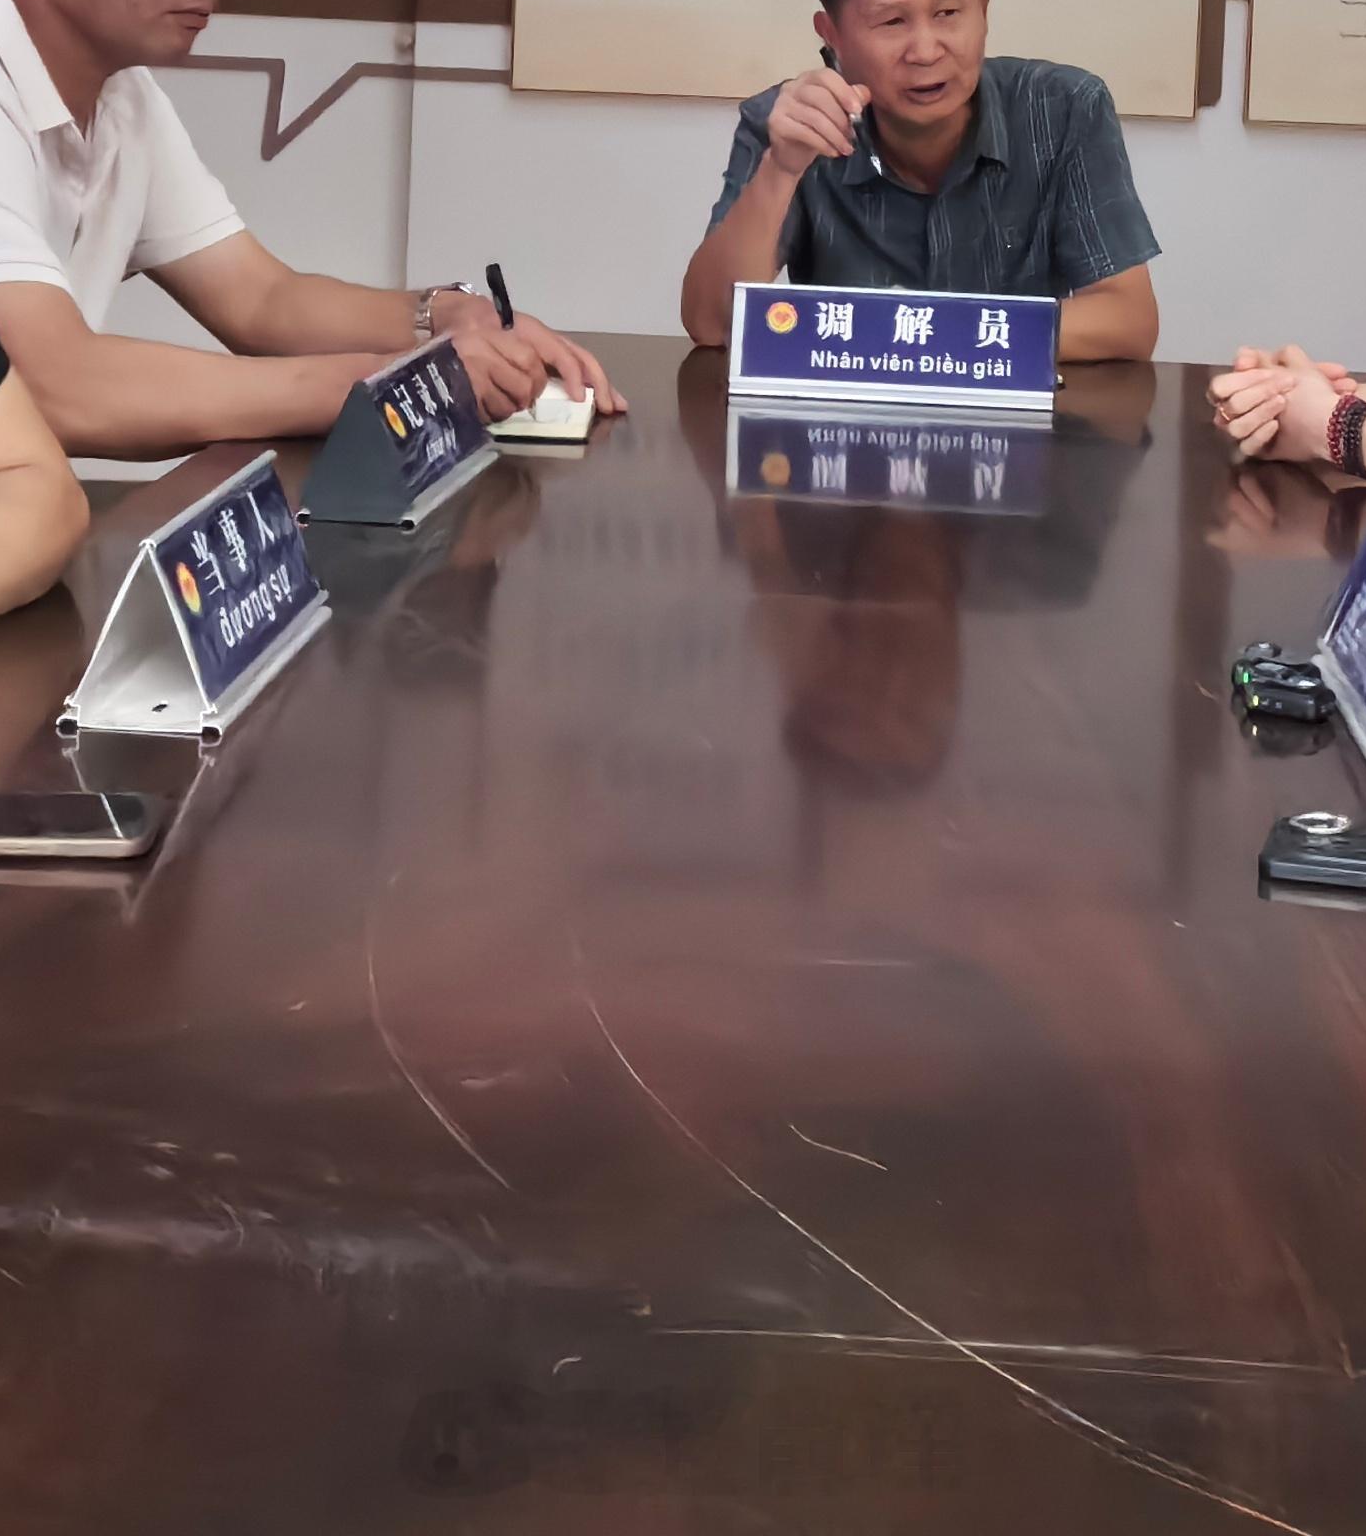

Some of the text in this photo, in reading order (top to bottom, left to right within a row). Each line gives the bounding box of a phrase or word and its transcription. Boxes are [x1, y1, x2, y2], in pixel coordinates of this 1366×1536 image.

[814, 302, 1011, 349] 调解员
[810, 350, 863, 371] Nhân
[870, 353, 914, 373] viên
[920, 355, 967, 375] Điều
[190, 491, 275, 595] 当事人
